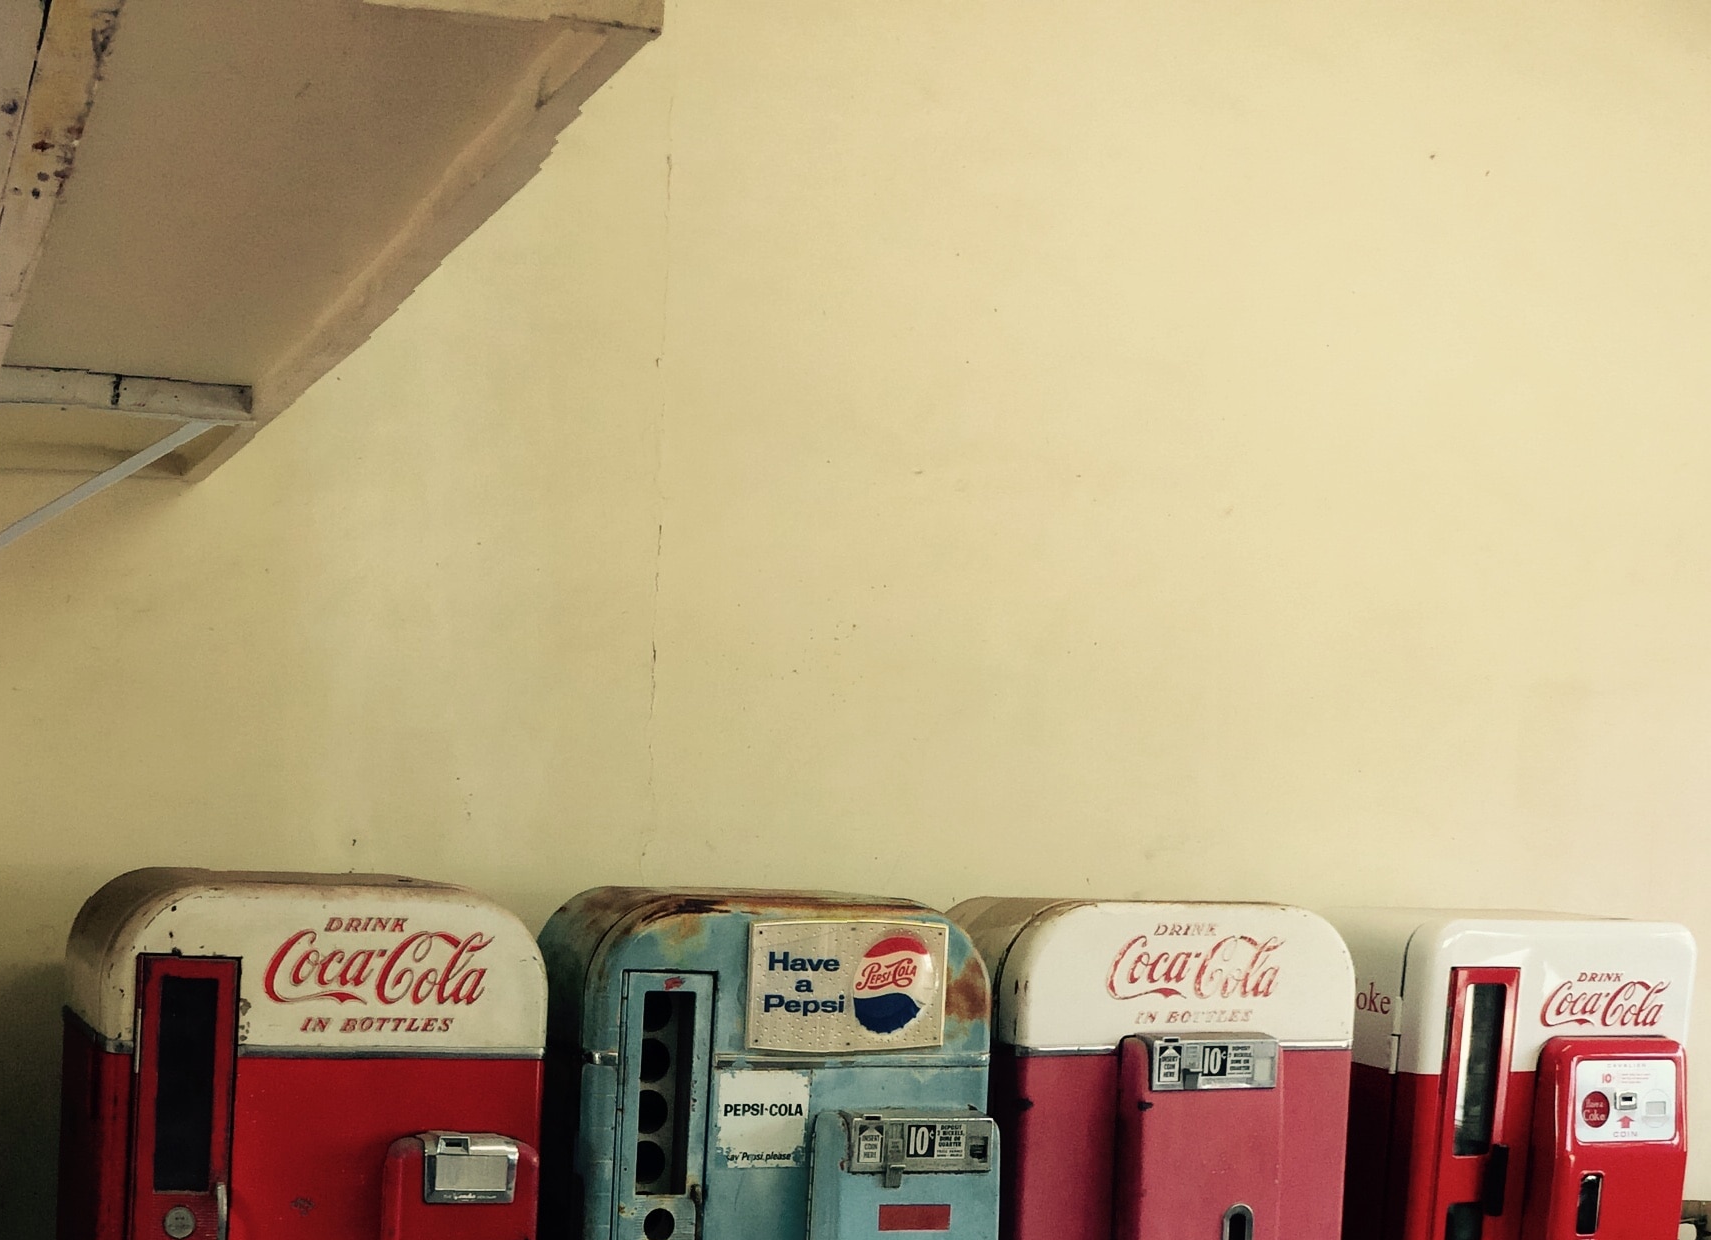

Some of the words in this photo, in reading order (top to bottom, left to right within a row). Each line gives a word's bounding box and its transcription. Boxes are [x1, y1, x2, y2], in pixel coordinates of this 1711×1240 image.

[325, 917, 409, 933] DRINK
[1154, 923, 1218, 936] DRINK
[263, 928, 495, 1006] Coca-Cola
[768, 951, 840, 972] Have
[1107, 935, 1286, 1000] Coca-Cola
[795, 979, 814, 992] a
[1576, 972, 1624, 982] DRINK
[764, 994, 846, 1017] Pepsi
[1355, 979, 1391, 1015] oke
[1540, 980, 1671, 1027] Coca-Cola
[300, 1016, 331, 1033] IN
[340, 1016, 454, 1034] BOTTLES
[1135, 1011, 1158, 1025] IN
[1165, 1009, 1253, 1024] BOTTLES
[1583, 1110, 1606, 1121] Coke
